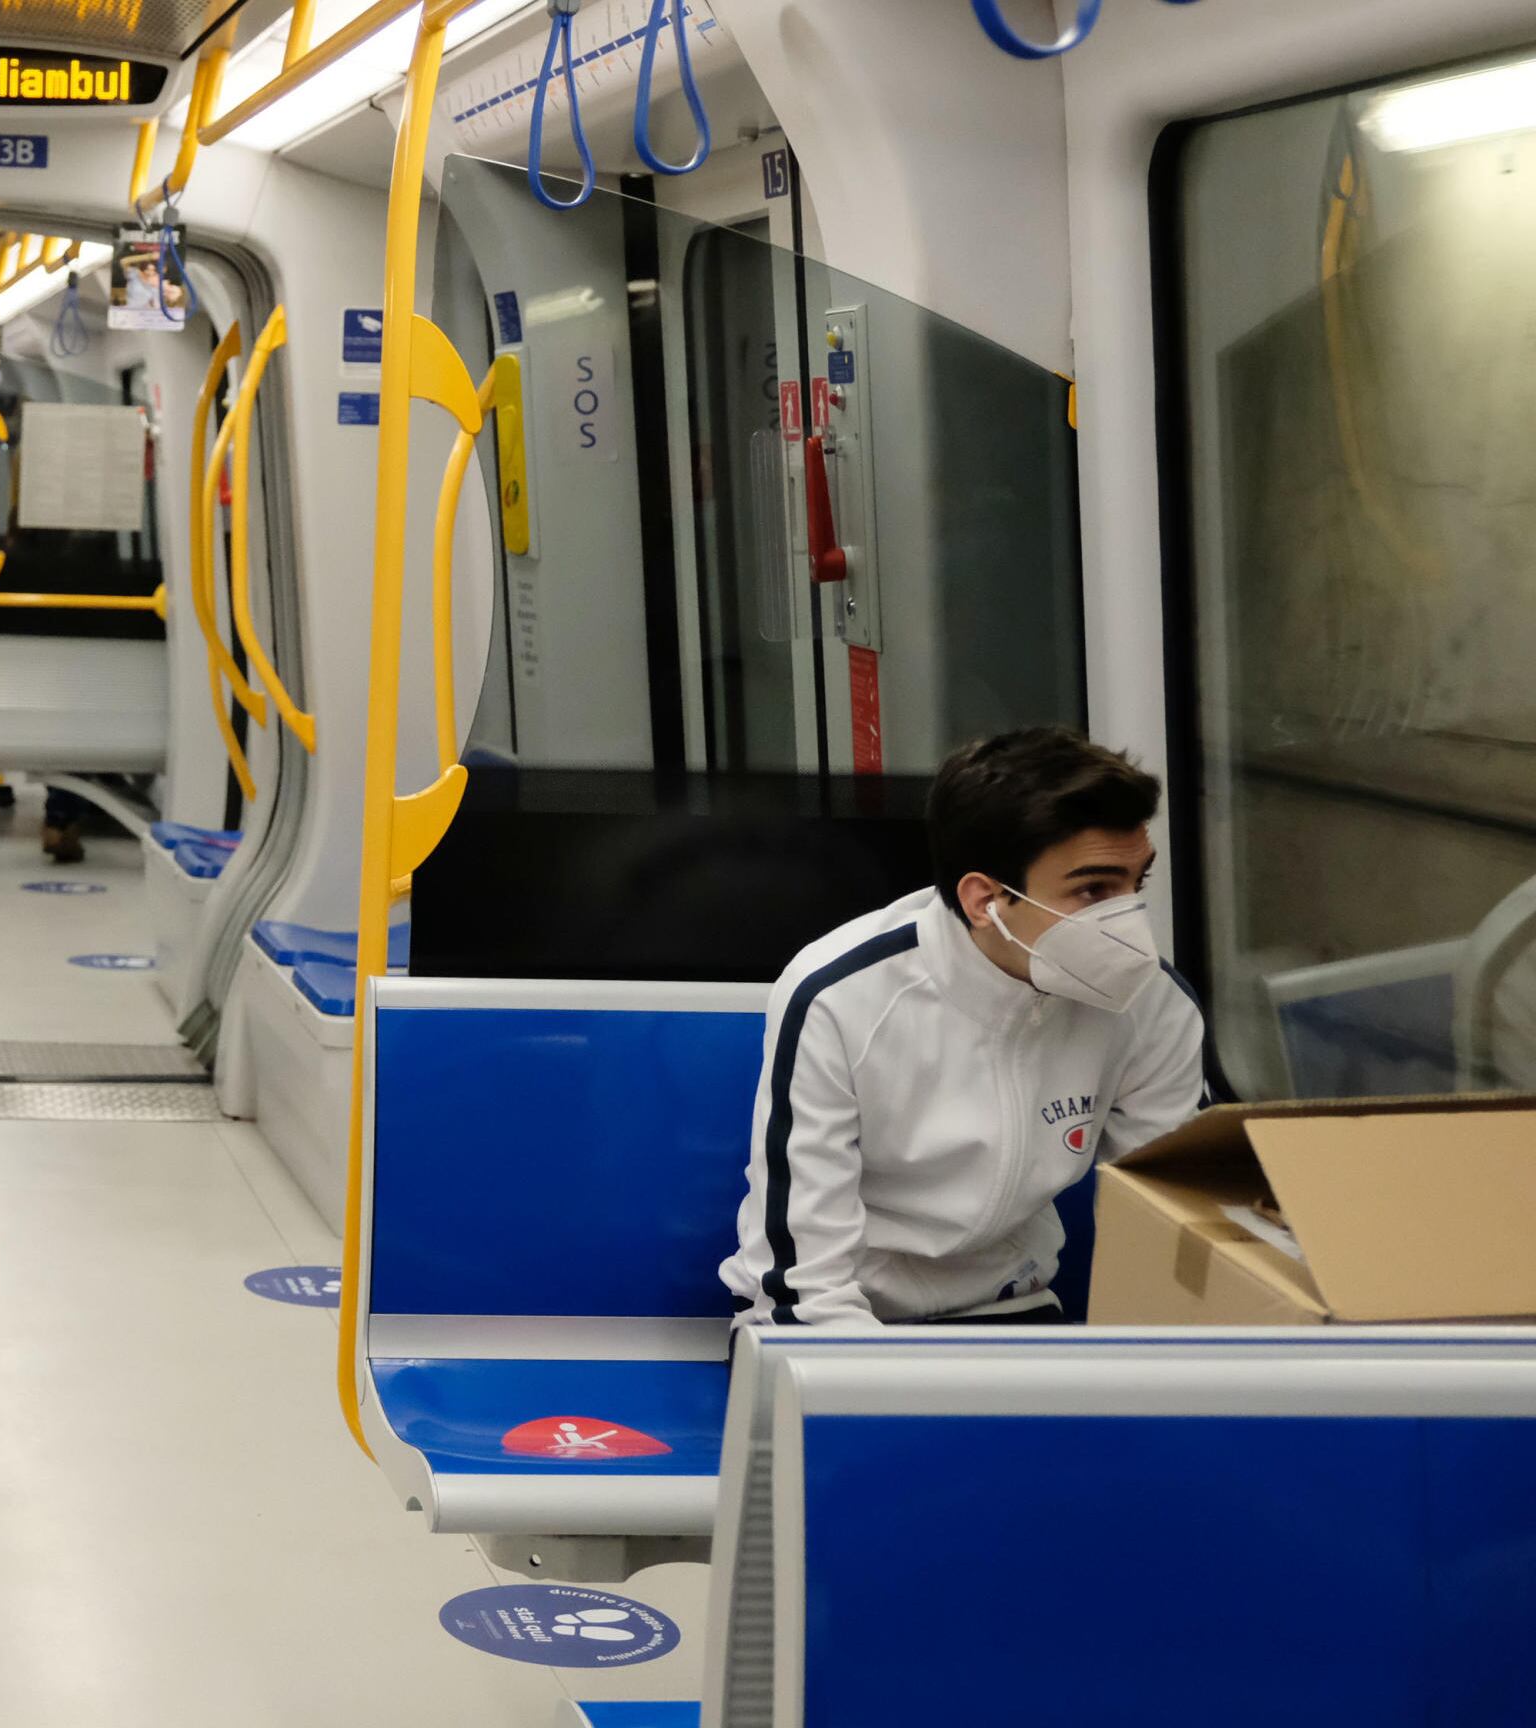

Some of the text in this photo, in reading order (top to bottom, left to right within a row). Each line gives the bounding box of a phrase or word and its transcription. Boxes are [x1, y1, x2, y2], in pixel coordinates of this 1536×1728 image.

[574, 356, 599, 448] SOS
[513, 1607, 553, 1643] stai qui!
[549, 1588, 616, 1604] durante
[630, 1607, 664, 1632] viaggio
